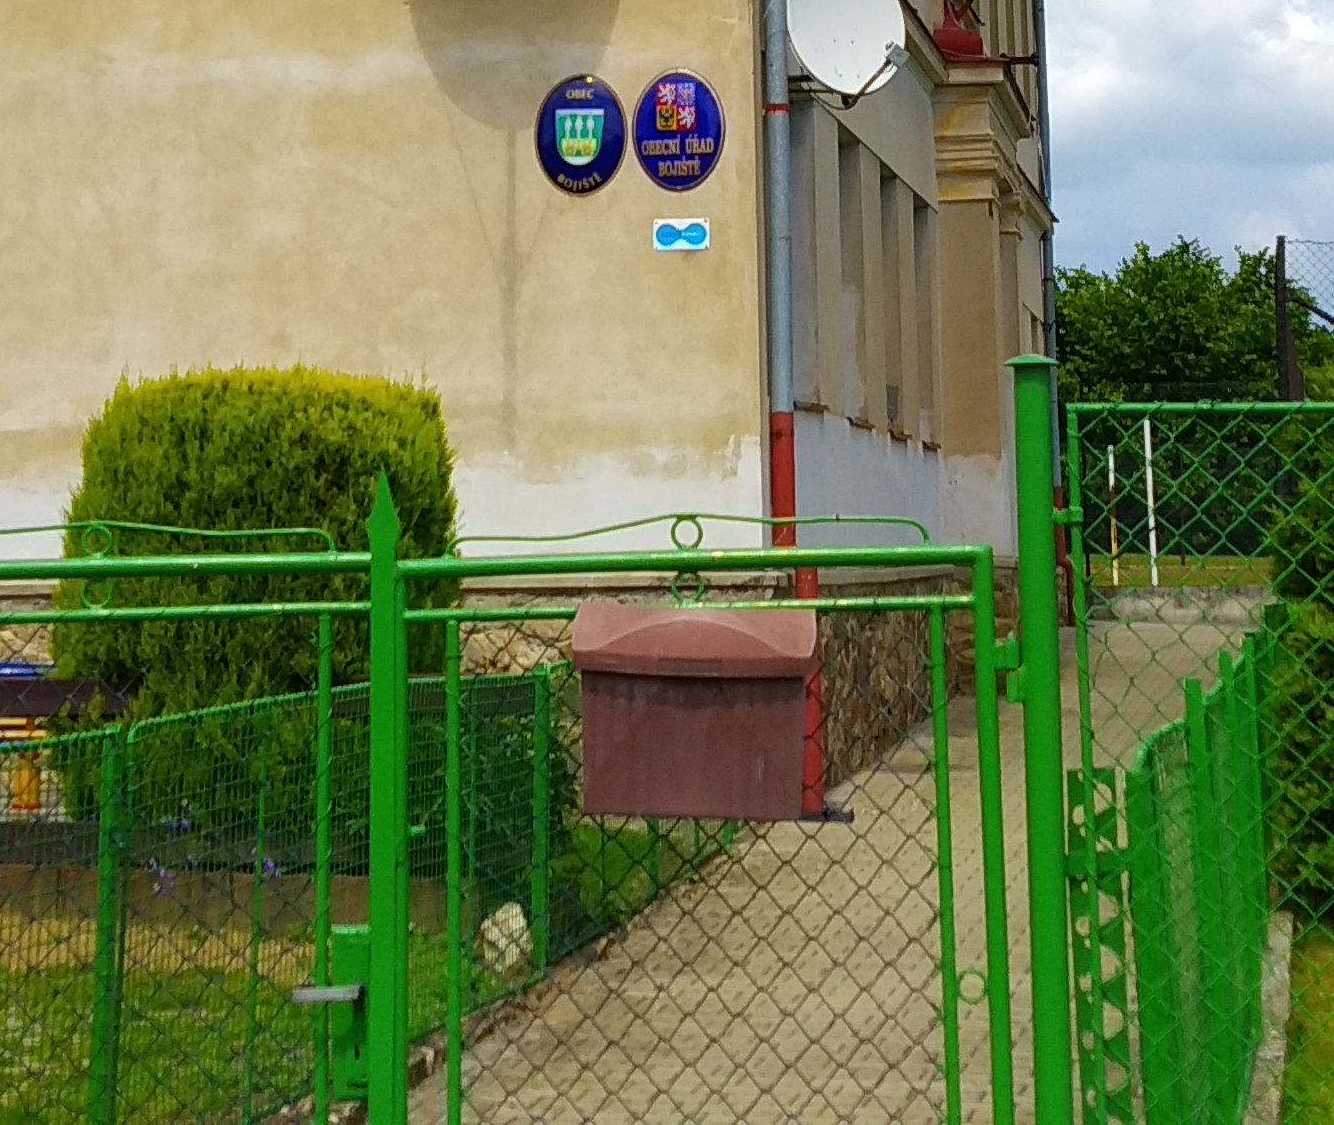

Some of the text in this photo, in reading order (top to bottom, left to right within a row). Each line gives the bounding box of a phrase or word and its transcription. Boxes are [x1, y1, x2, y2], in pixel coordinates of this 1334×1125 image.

[566, 88, 595, 99] OBEC
[642, 133, 714, 155] OBECNÍ ÚŘAD
[658, 156, 700, 177] BOJIŠTĚ
